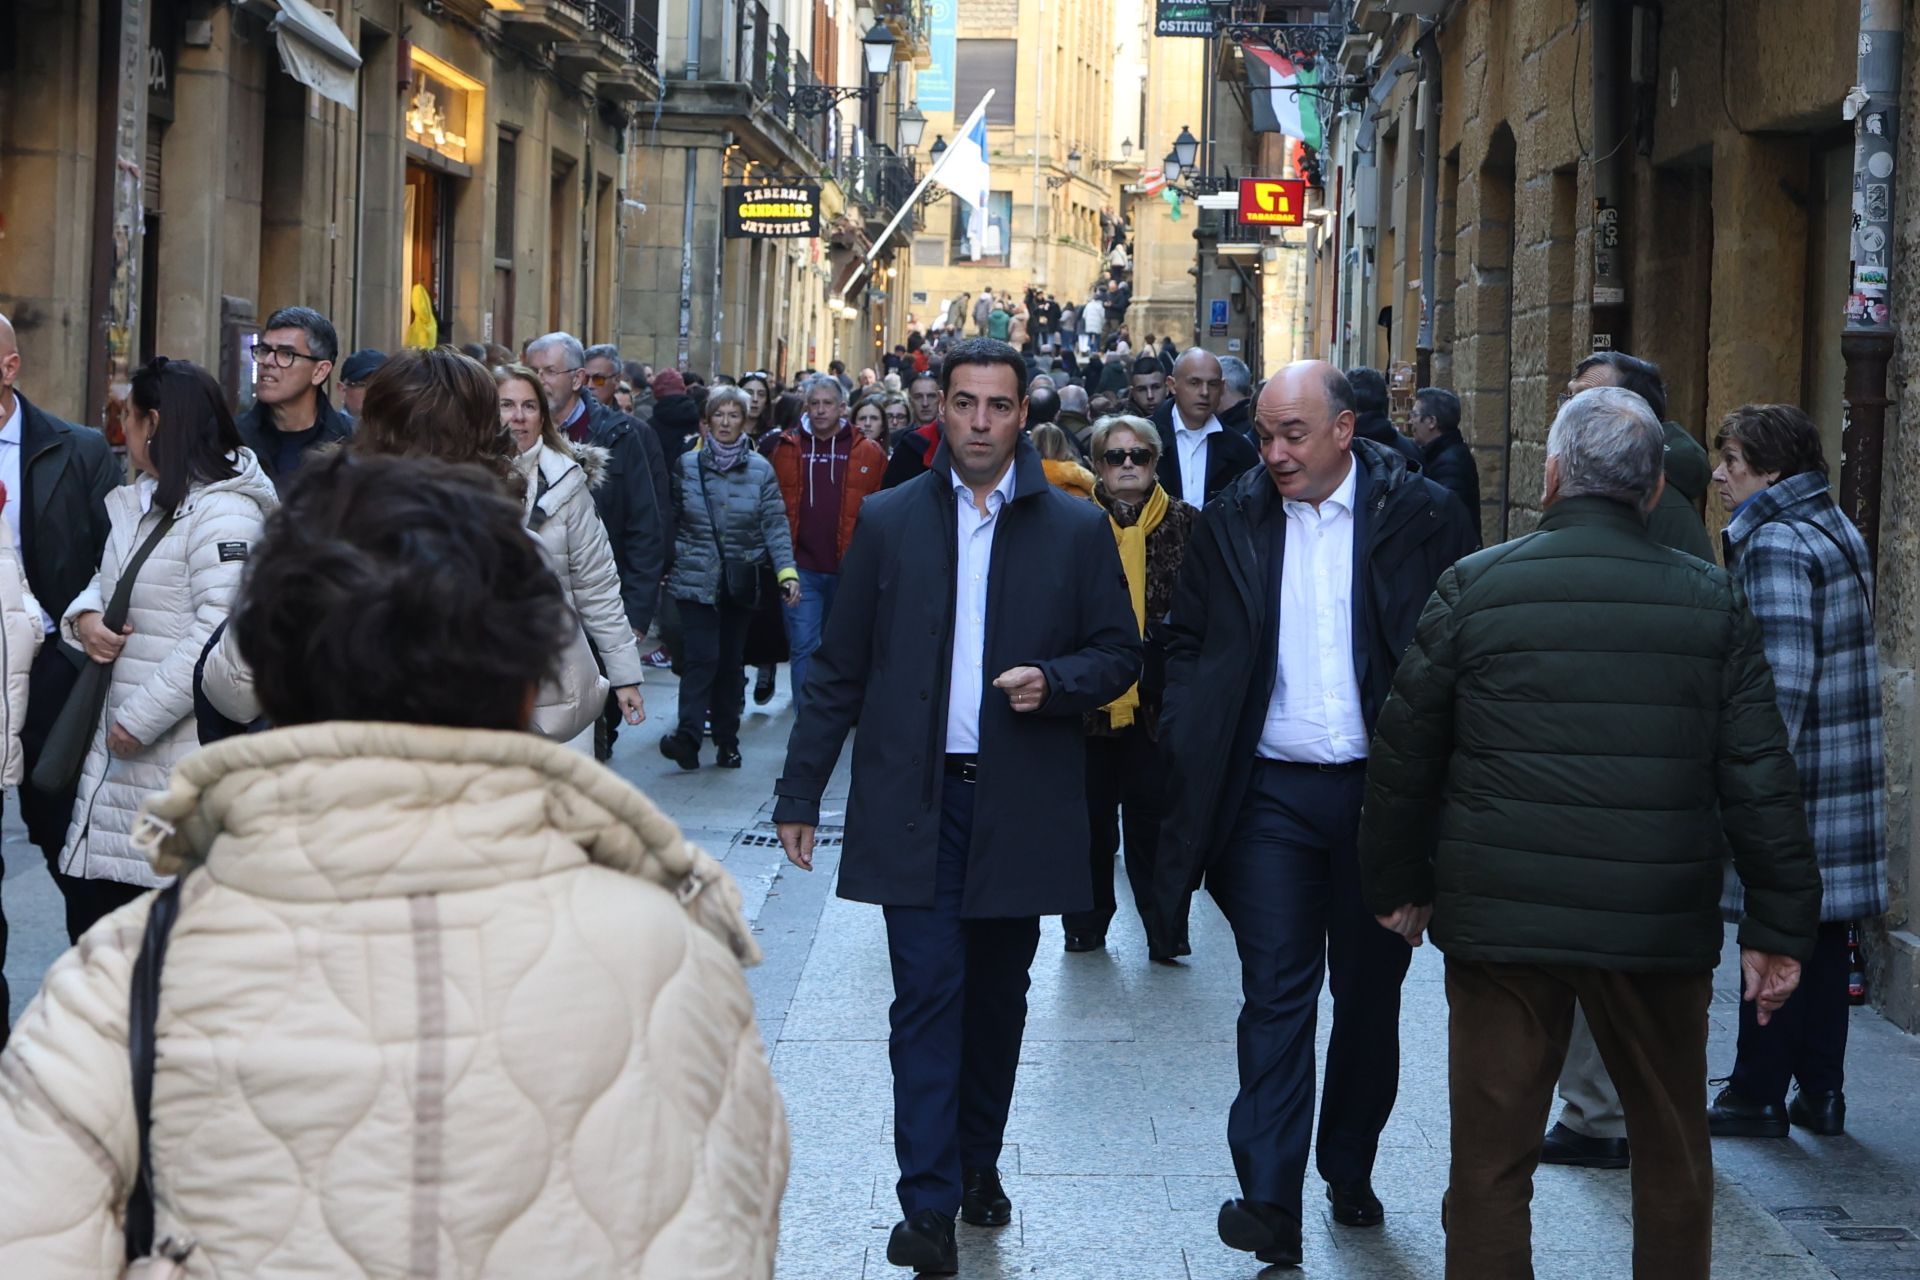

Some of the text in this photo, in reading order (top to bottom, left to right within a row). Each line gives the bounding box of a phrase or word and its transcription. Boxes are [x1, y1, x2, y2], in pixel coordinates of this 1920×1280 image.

[1159, 20, 1213, 33] OSTATUA
[744, 188, 808, 202] TABERNA
[740, 220, 811, 234] JATETXEA
